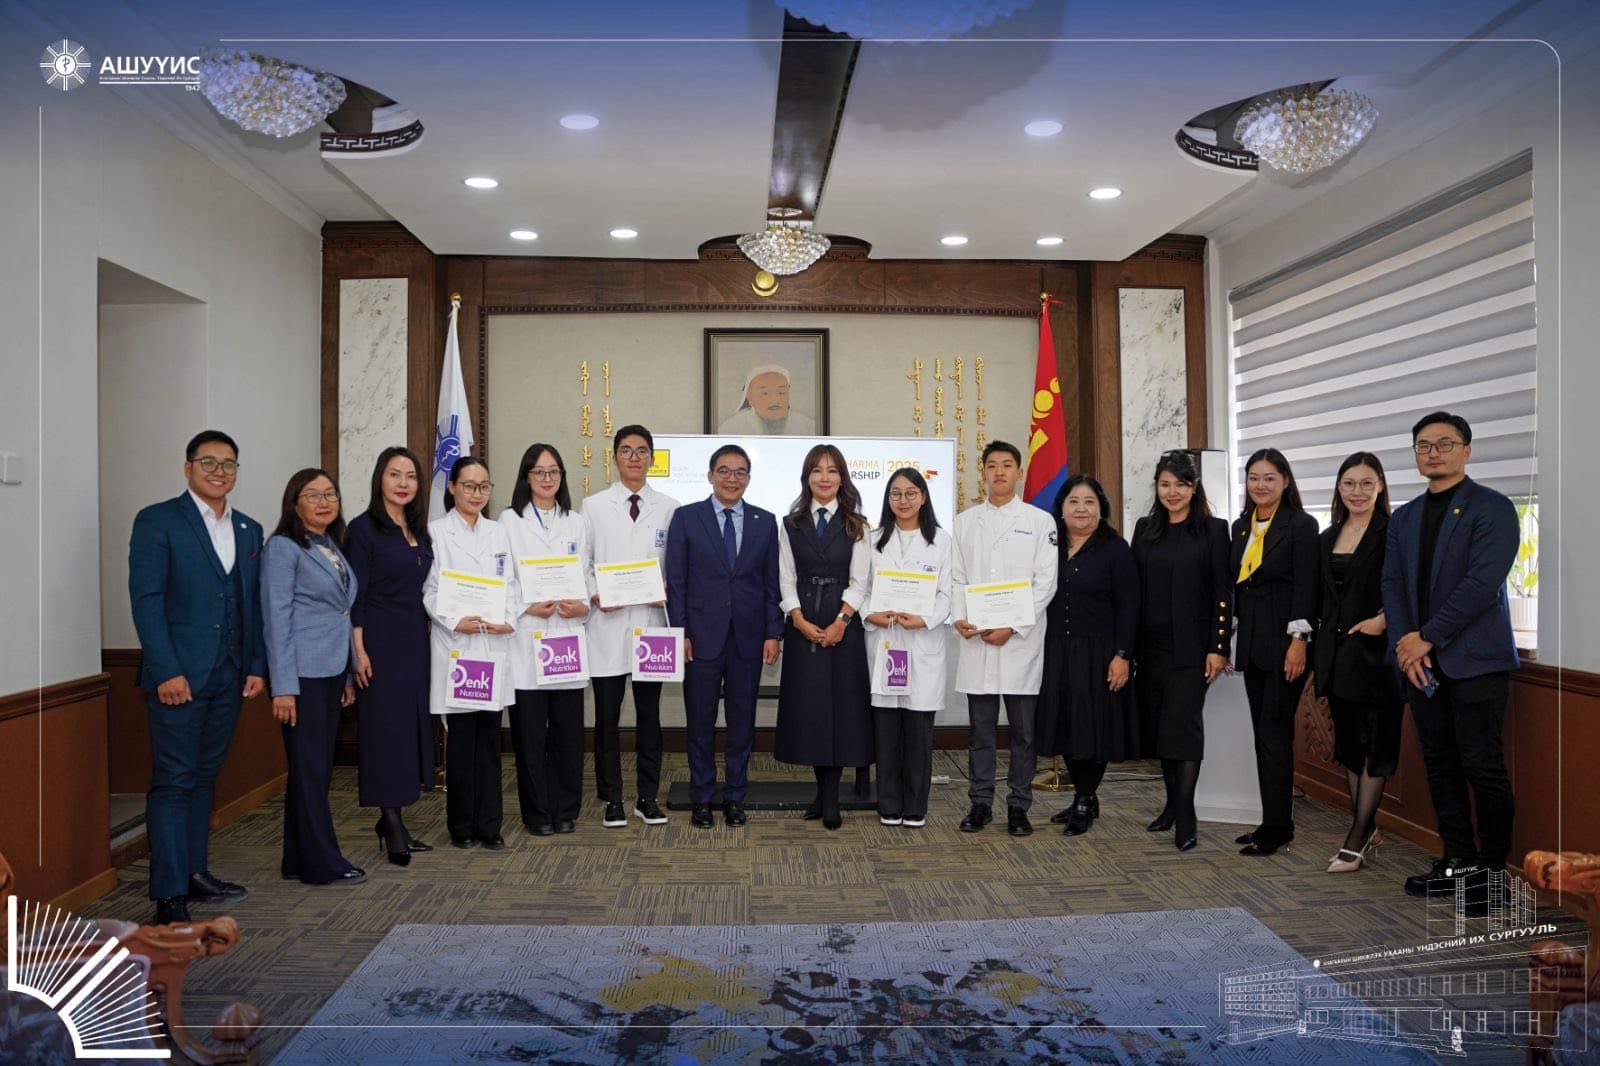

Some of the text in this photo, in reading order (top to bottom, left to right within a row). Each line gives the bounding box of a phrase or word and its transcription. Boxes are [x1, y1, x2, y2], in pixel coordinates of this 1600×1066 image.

[846, 460, 879, 469] HARMA
[850, 470, 880, 480] RSHIP
[539, 643, 578, 667] Denk
[636, 641, 673, 663] Denk
[549, 664, 578, 673] Nutrition
[645, 663, 673, 671] Nutrition
[451, 663, 489, 690] Denk
[460, 689, 489, 698] Nutrition
